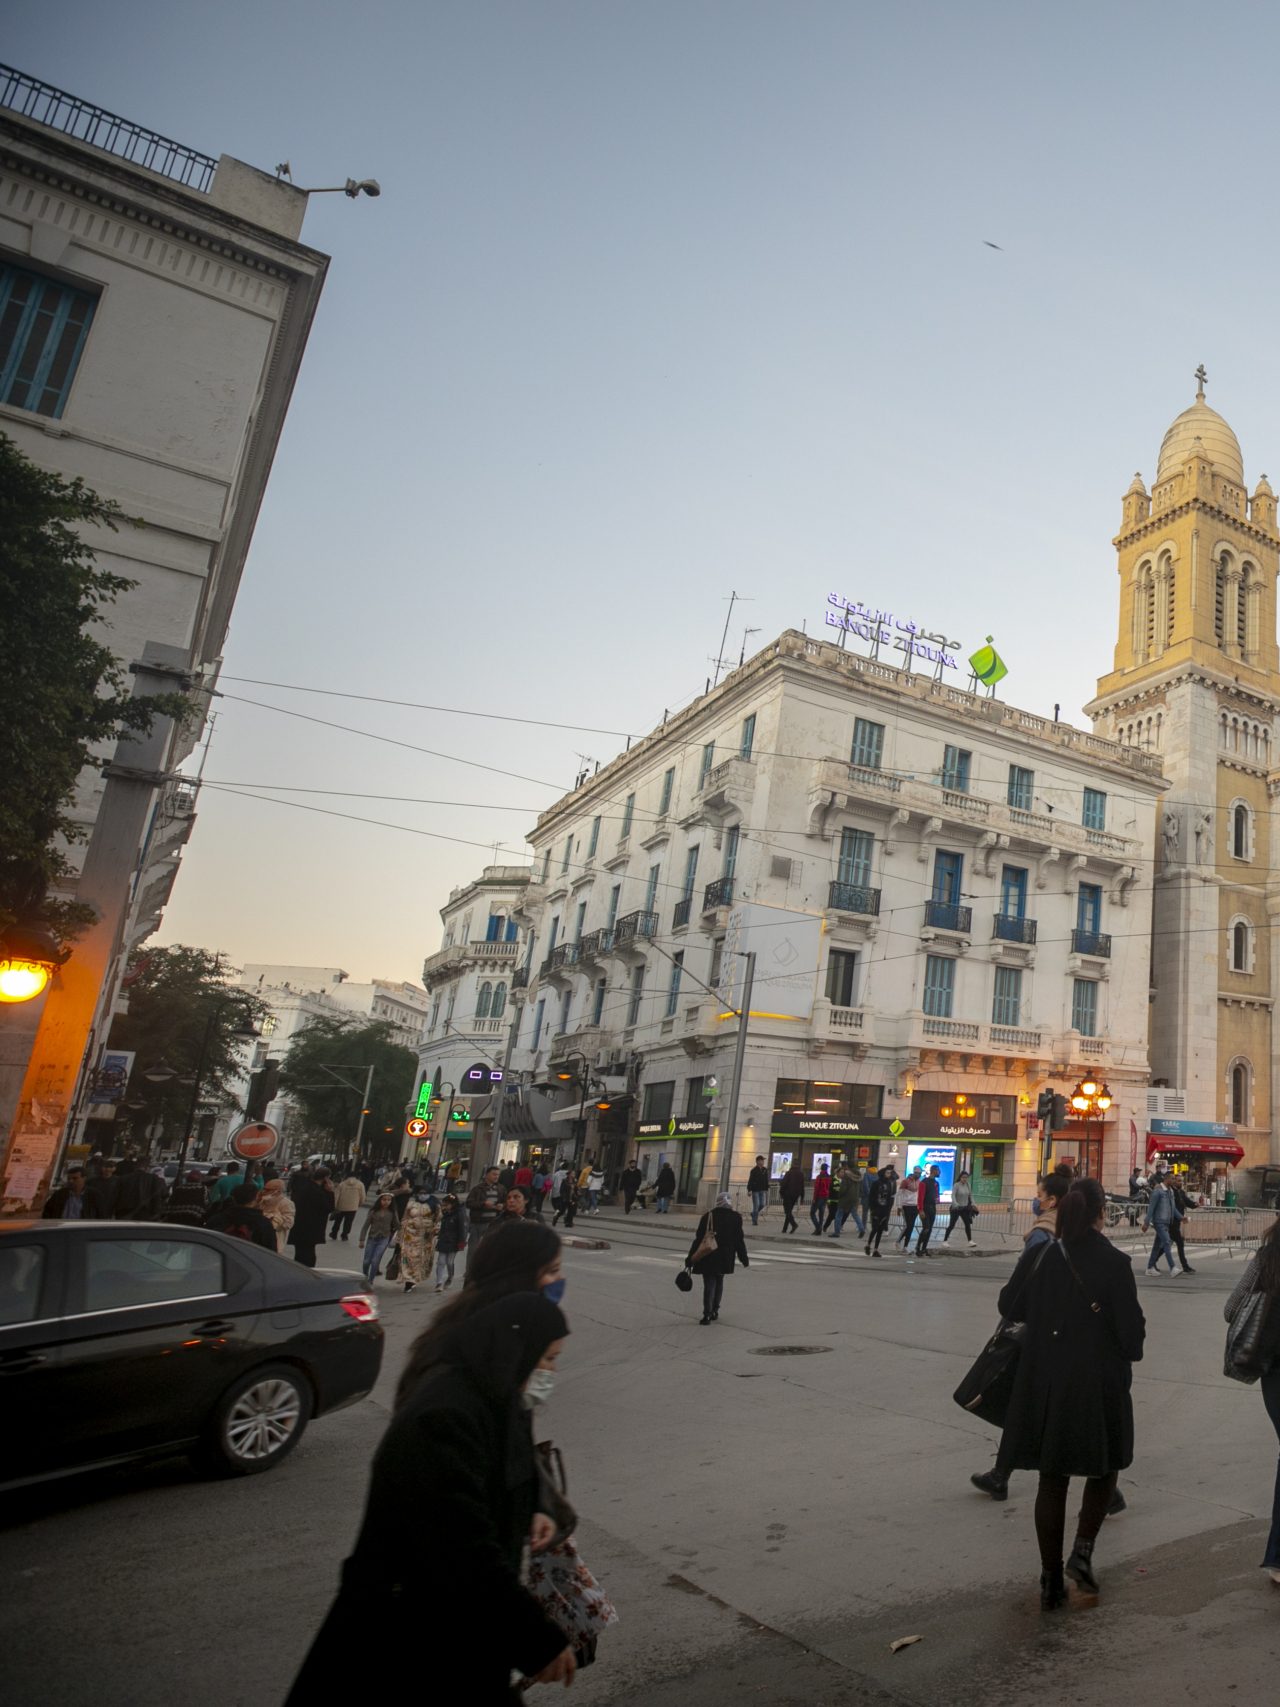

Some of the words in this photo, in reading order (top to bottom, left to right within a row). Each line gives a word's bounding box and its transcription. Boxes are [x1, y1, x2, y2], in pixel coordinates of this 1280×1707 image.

[827, 591, 894, 627] الزيتونة
[825, 611, 891, 645] BANQUE
[893, 635, 959, 669] ZITOUNA
[896, 617, 962, 650] مصرف
[799, 1121, 829, 1131] BANQUE
[829, 1122, 859, 1131] ZITOUNA
[940, 1125, 965, 1134] الزيتونة
[965, 1127, 991, 1135] مصرف
